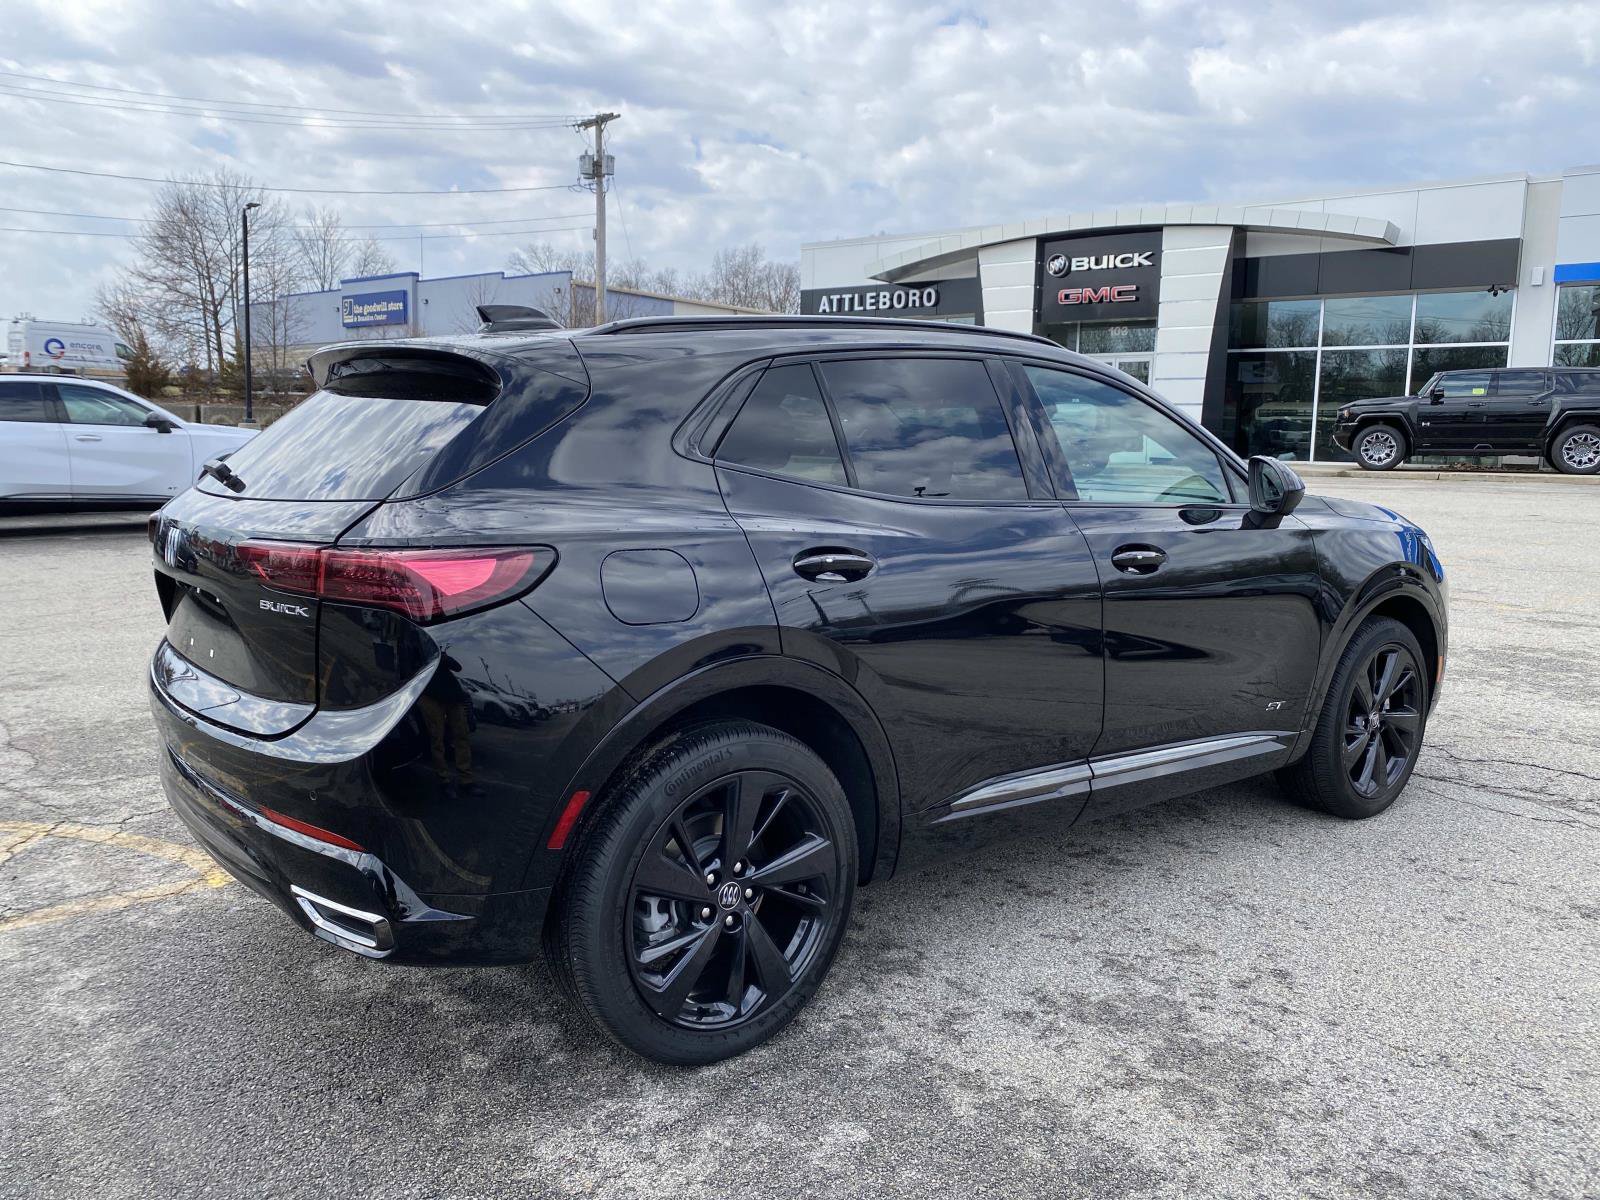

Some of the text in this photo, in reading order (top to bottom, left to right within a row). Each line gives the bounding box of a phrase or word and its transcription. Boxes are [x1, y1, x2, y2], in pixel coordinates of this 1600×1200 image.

[1070, 251, 1153, 272] BUICK
[818, 287, 937, 313] ATTLEBORO
[1057, 284, 1137, 305] GMC
[353, 302, 403, 315] the goodwill store
[70, 342, 102, 350] encore
[259, 599, 310, 617] BUICK
[664, 750, 726, 796] Continental
